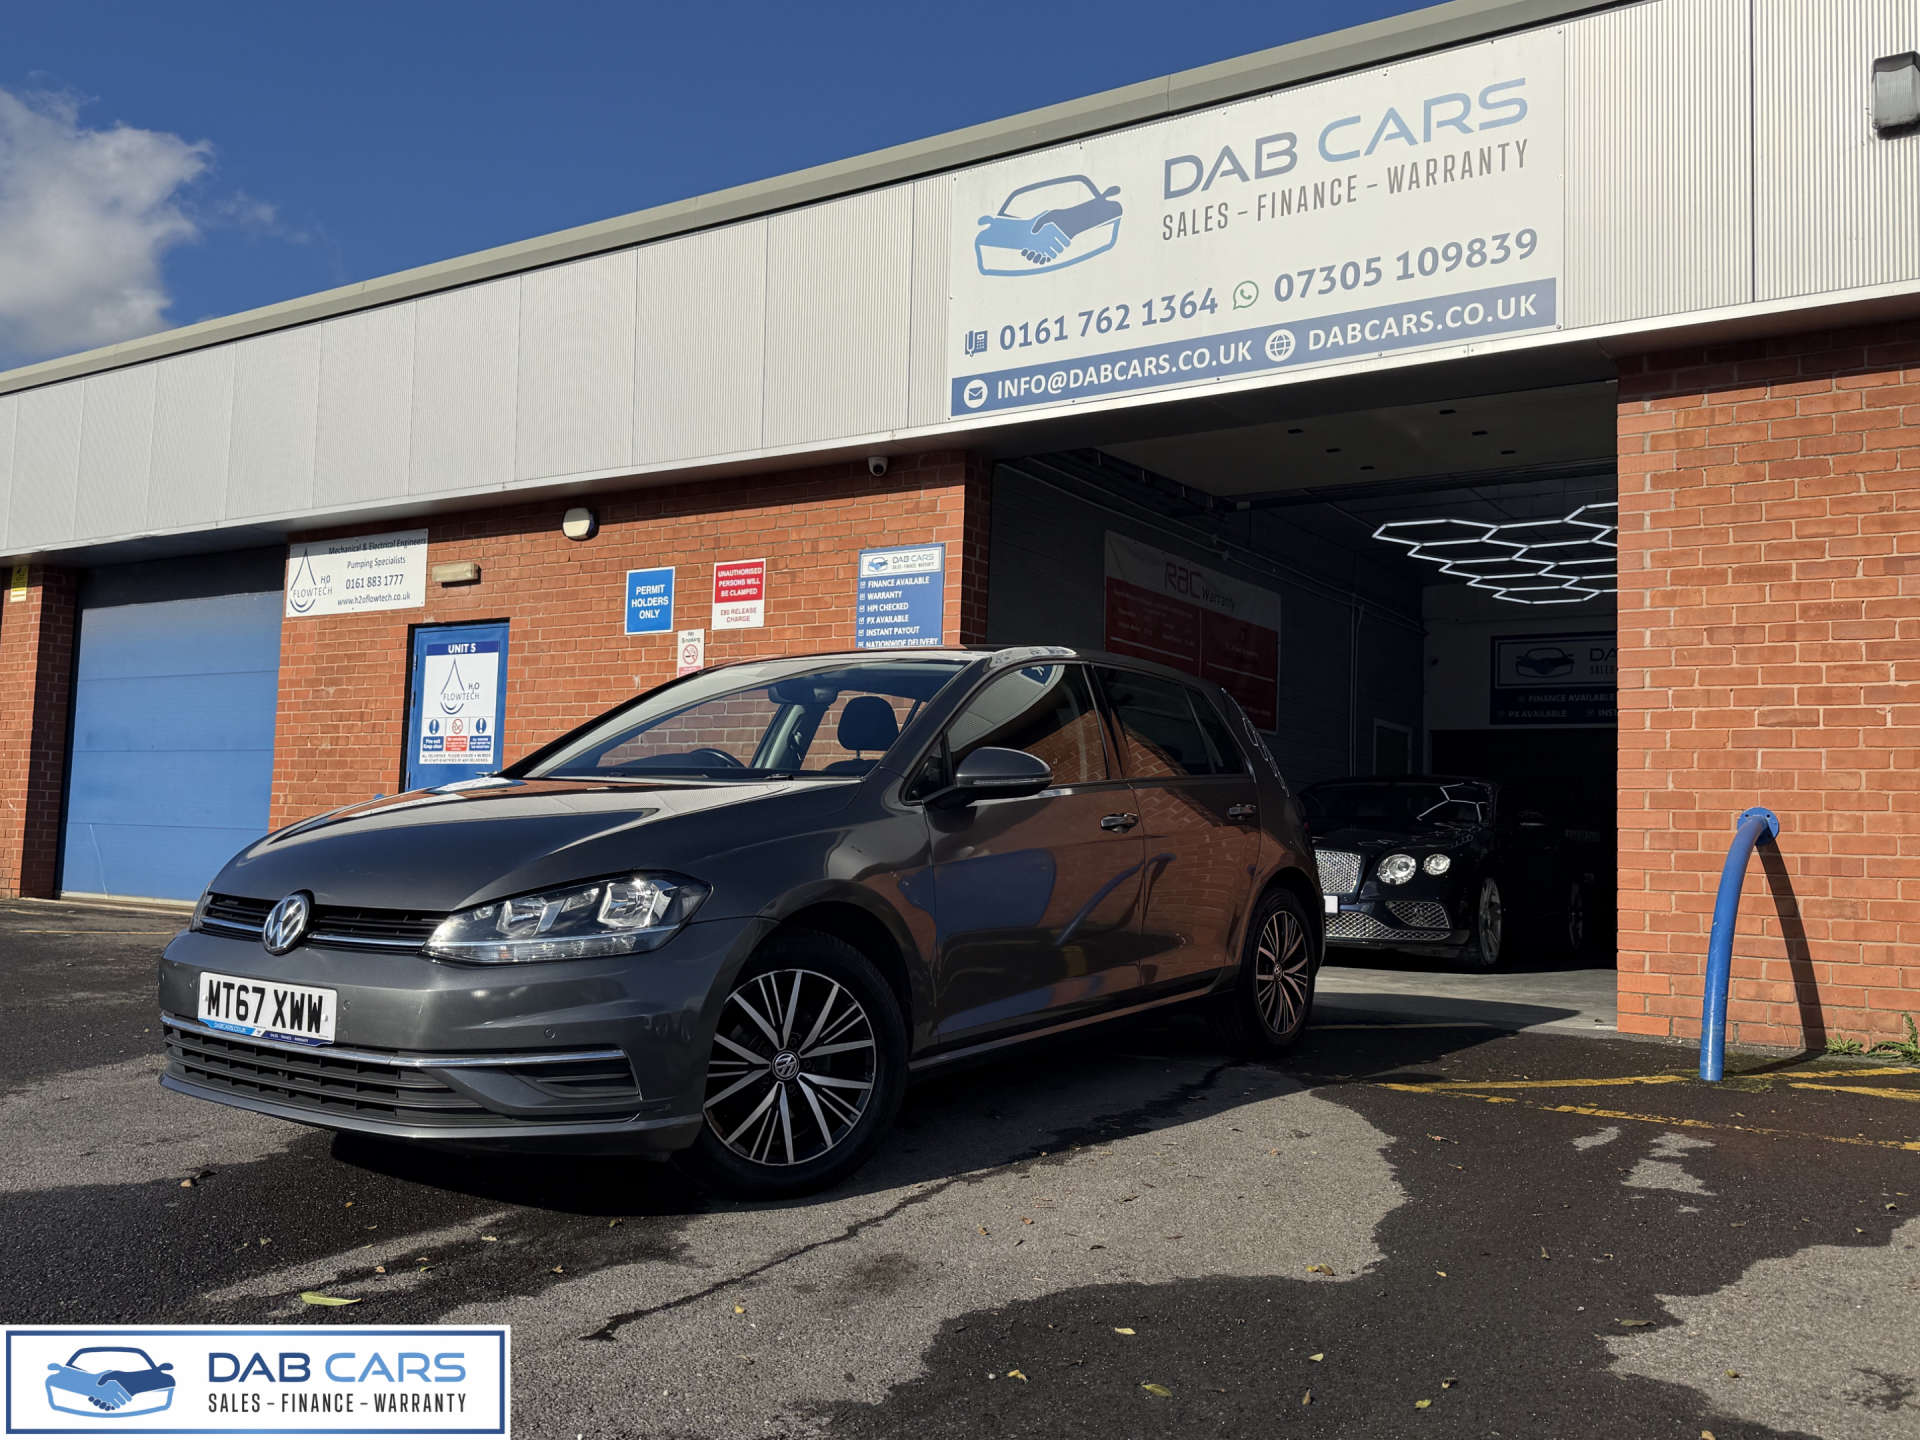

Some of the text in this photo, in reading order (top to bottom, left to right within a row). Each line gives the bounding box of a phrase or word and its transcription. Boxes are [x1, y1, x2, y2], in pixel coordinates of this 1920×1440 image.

[1163, 77, 1528, 200] DAB CARS
[1162, 201, 1229, 241] SALES
[1257, 174, 1357, 223] FINANCE
[1387, 138, 1529, 195] WARRANTY
[1273, 228, 1538, 302] 07305 109839
[999, 287, 1218, 350] 0161 762 1364
[1308, 293, 1537, 351] DABCARS.CO.UK
[997, 339, 1253, 399] INFO@DABCARS.CO.UK
[397, 537, 427, 548] Engineers
[347, 555, 406, 569] Pumping Specialists
[717, 567, 762, 577] UNAUTHORISED
[345, 573, 404, 590] 0161 883 1777
[718, 577, 761, 587] PERSONS WILL
[868, 576, 930, 588] FINANCE AVAILABLE
[293, 587, 333, 598] FLOWTECH
[636, 584, 665, 596] PERMIT
[730, 588, 758, 596] CLAMPED
[337, 592, 411, 607] www.h2oflowtech.co.uk
[867, 591, 903, 601] WARRANTY
[631, 596, 669, 608] HOLDERS
[867, 602, 909, 612] HPI CHECKED
[639, 609, 661, 619] ONLY
[731, 607, 757, 615] RELEASE
[726, 615, 751, 623] CHARGE
[866, 614, 909, 625] PX AVAILABLE
[866, 626, 920, 637] INSTANT PAYOUT
[448, 643, 469, 654] UNIT
[866, 639, 906, 648] NATIONWIDE
[442, 691, 480, 702] FLOWTECH
[208, 980, 323, 1033] MT67 XWW
